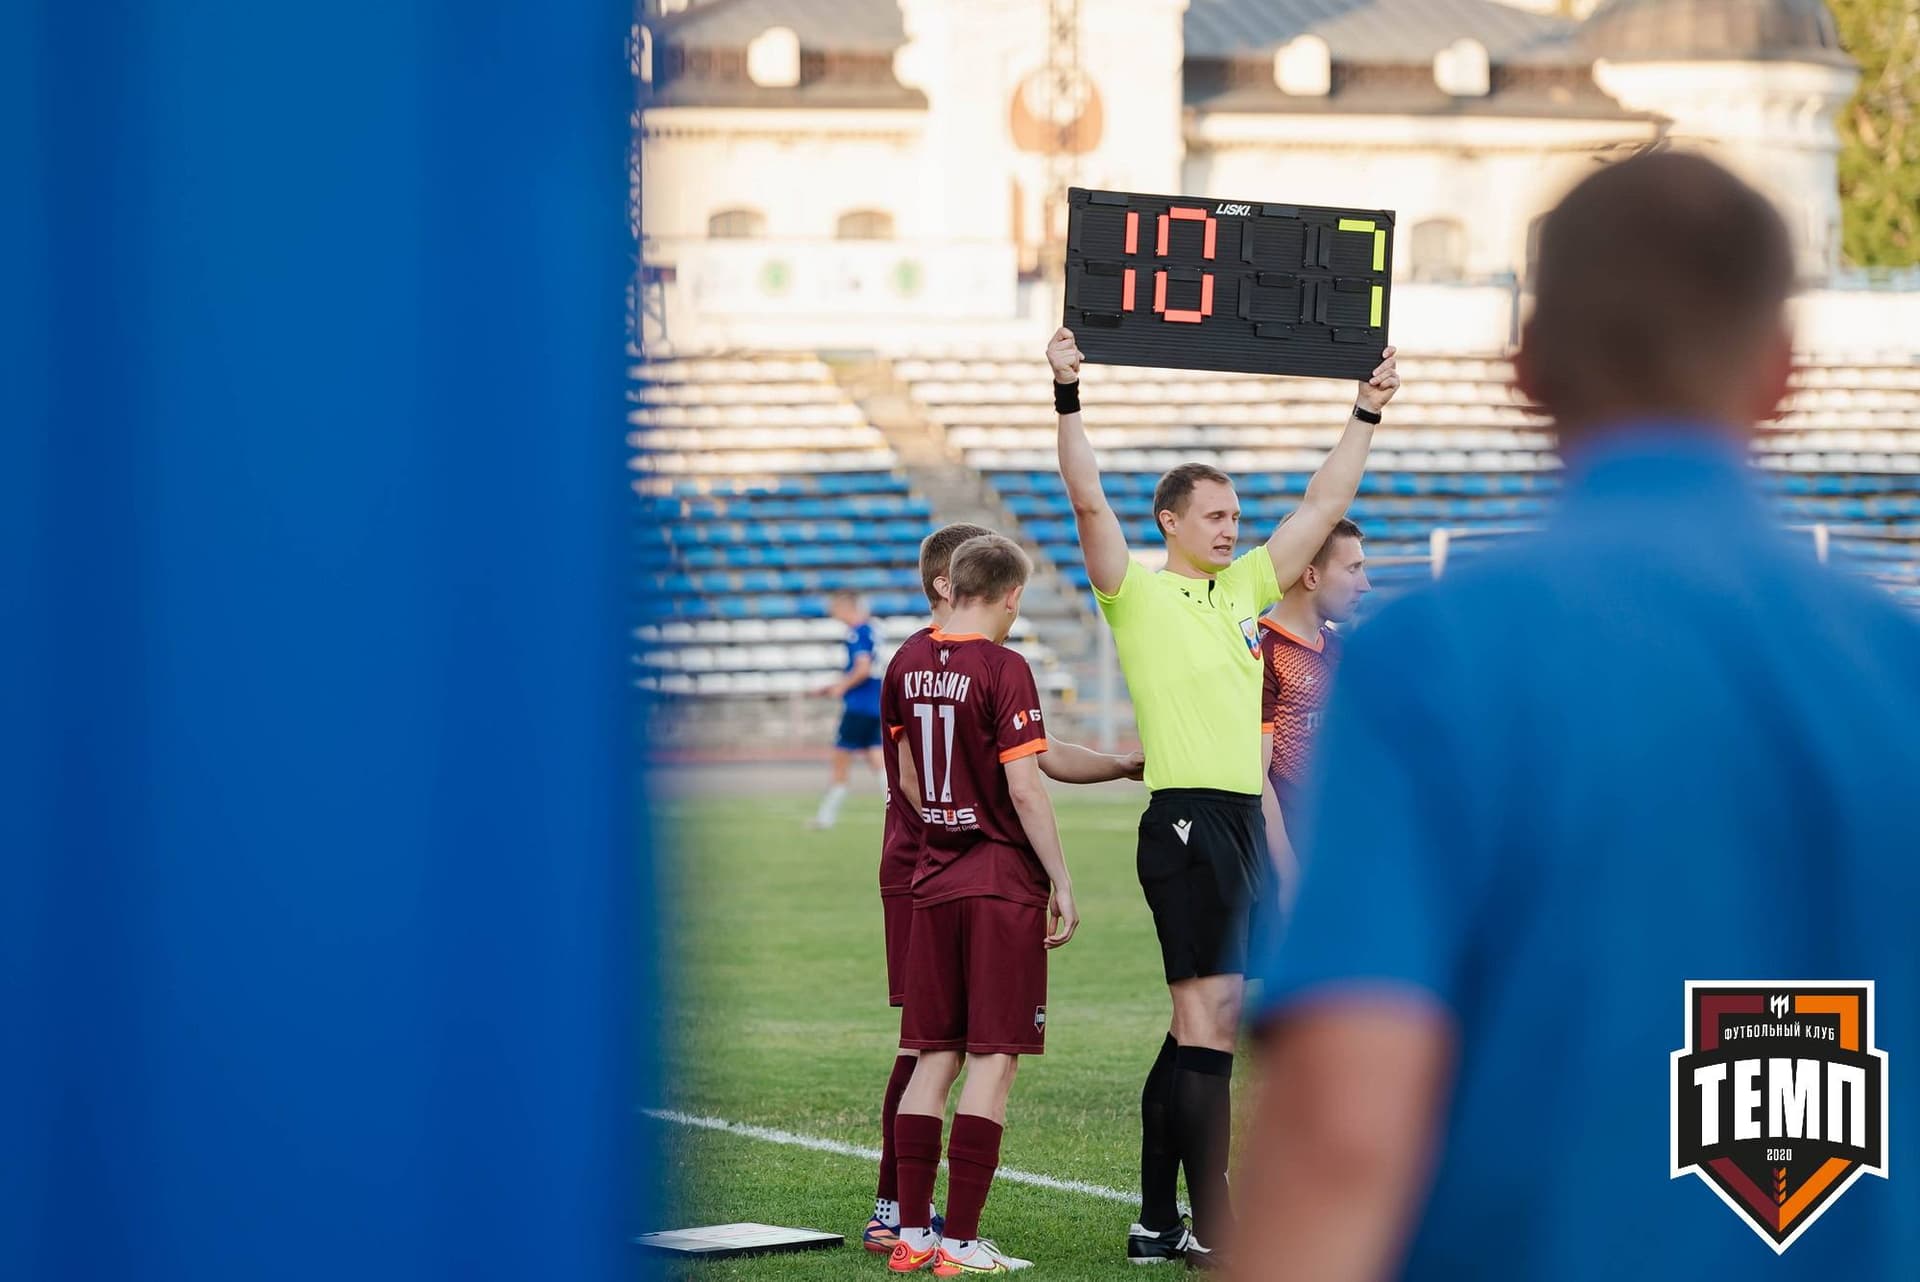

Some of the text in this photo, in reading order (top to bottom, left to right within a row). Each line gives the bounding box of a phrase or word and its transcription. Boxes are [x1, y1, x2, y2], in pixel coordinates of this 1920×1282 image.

[1122, 207, 1386, 328] 10 7
[914, 704, 955, 802] 11
